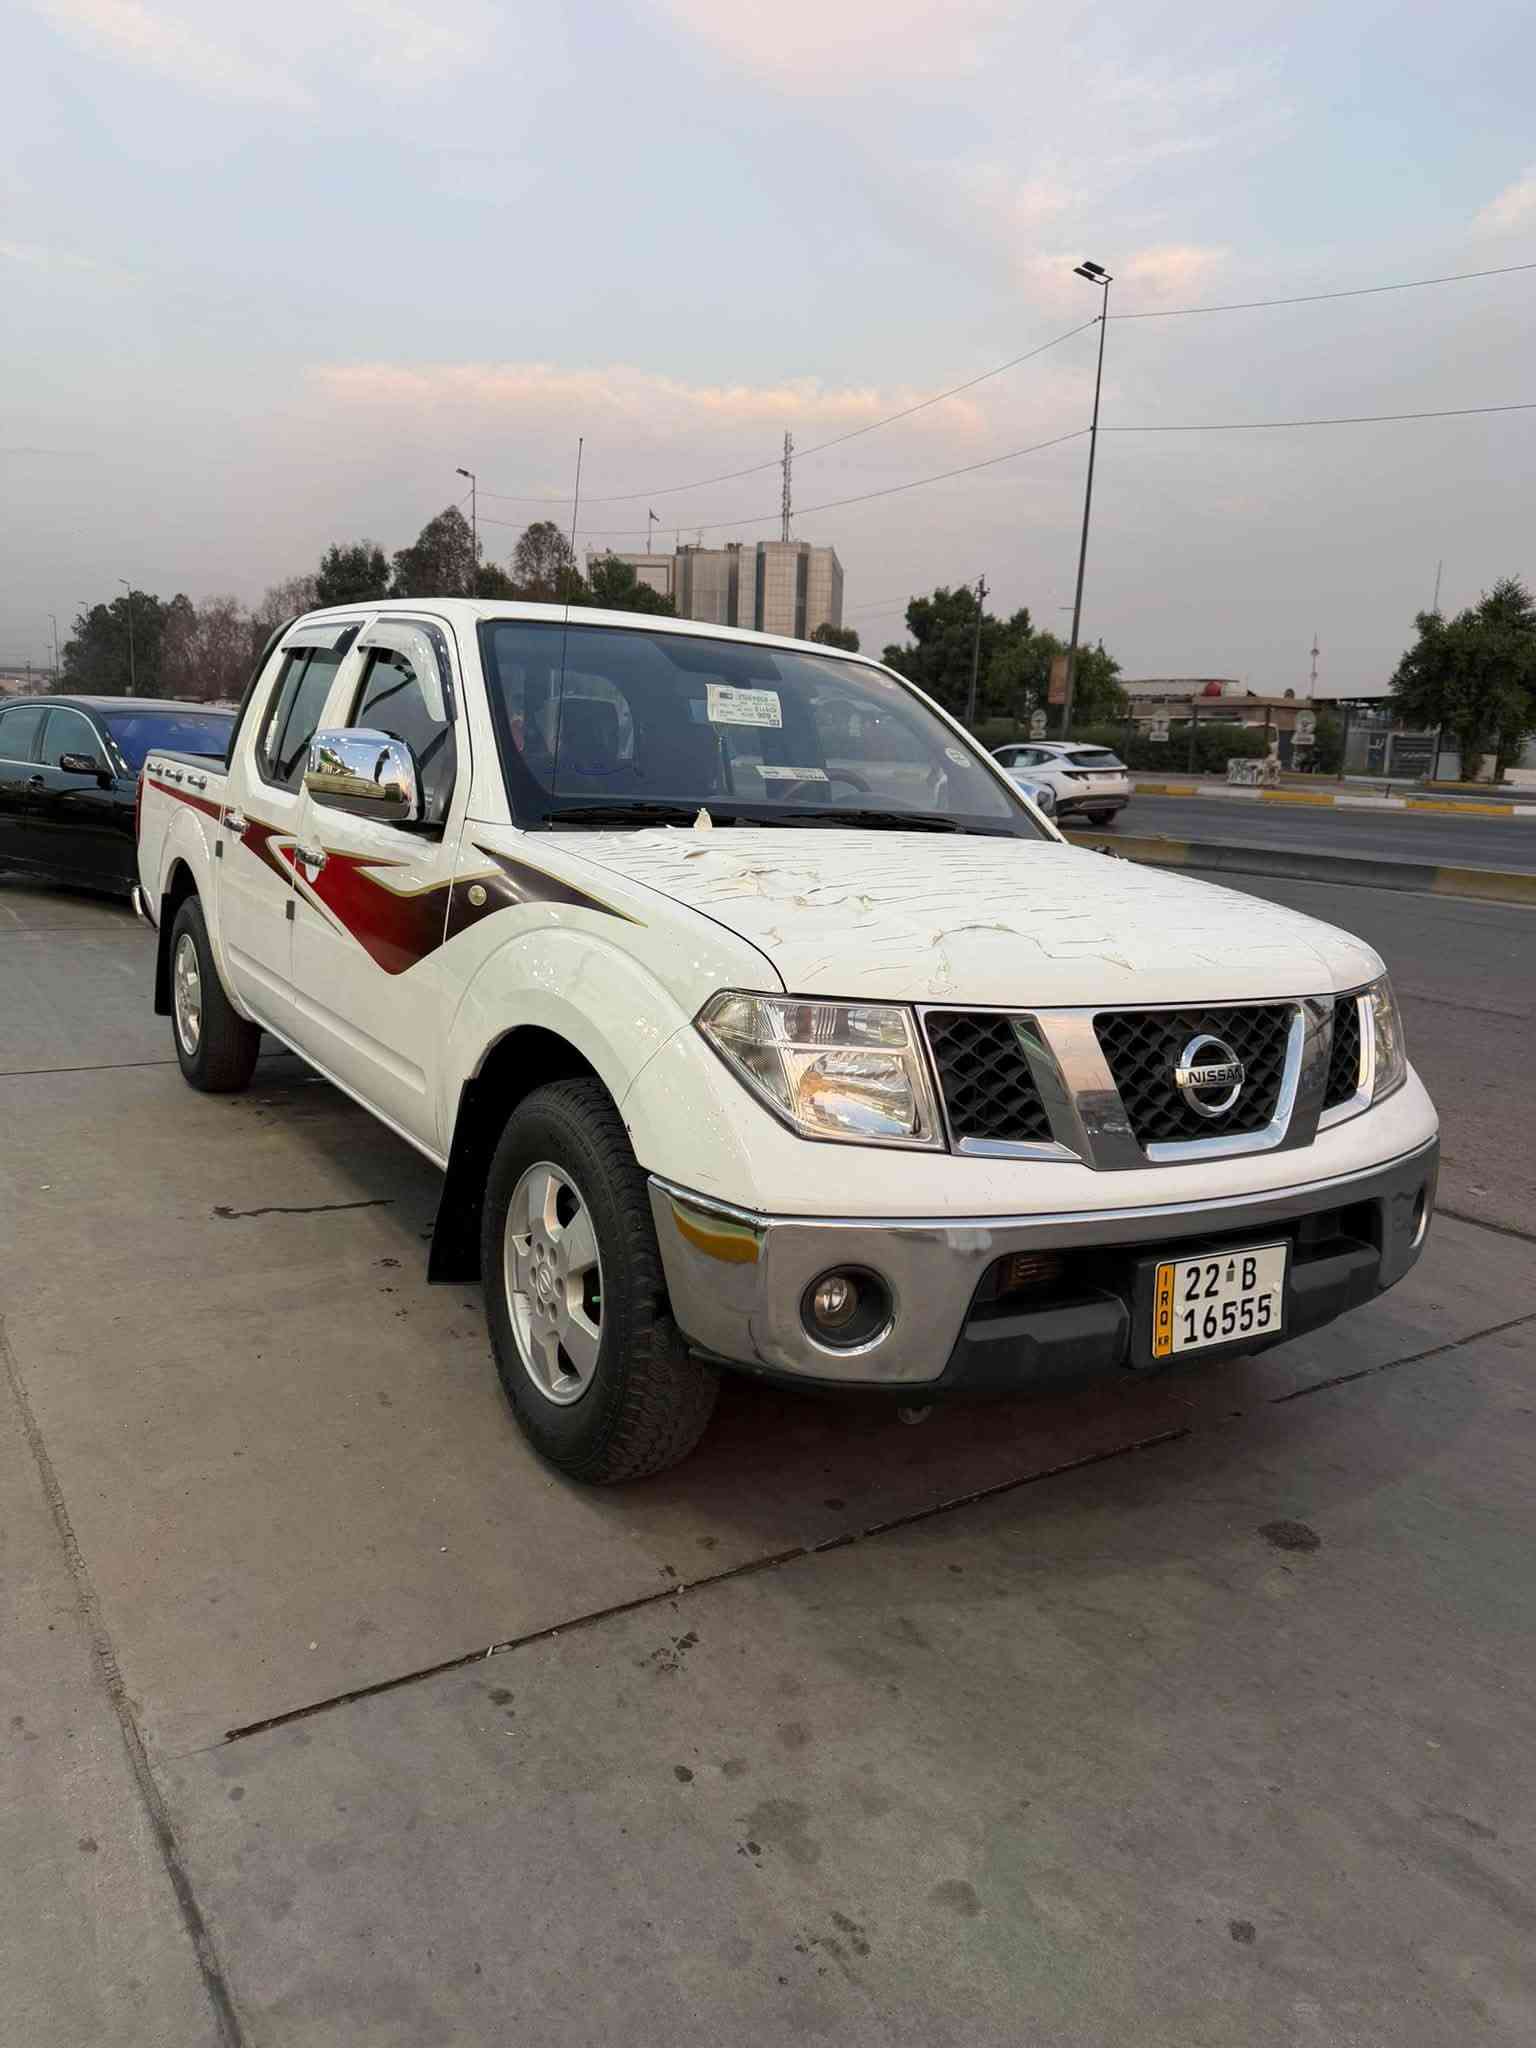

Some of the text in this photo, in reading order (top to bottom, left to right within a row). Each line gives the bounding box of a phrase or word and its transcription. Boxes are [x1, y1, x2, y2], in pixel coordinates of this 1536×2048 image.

[1188, 1068, 1241, 1083] NISSAN
[1185, 1257, 1256, 1301] 22 B
[1183, 1293, 1272, 1344] 16555
